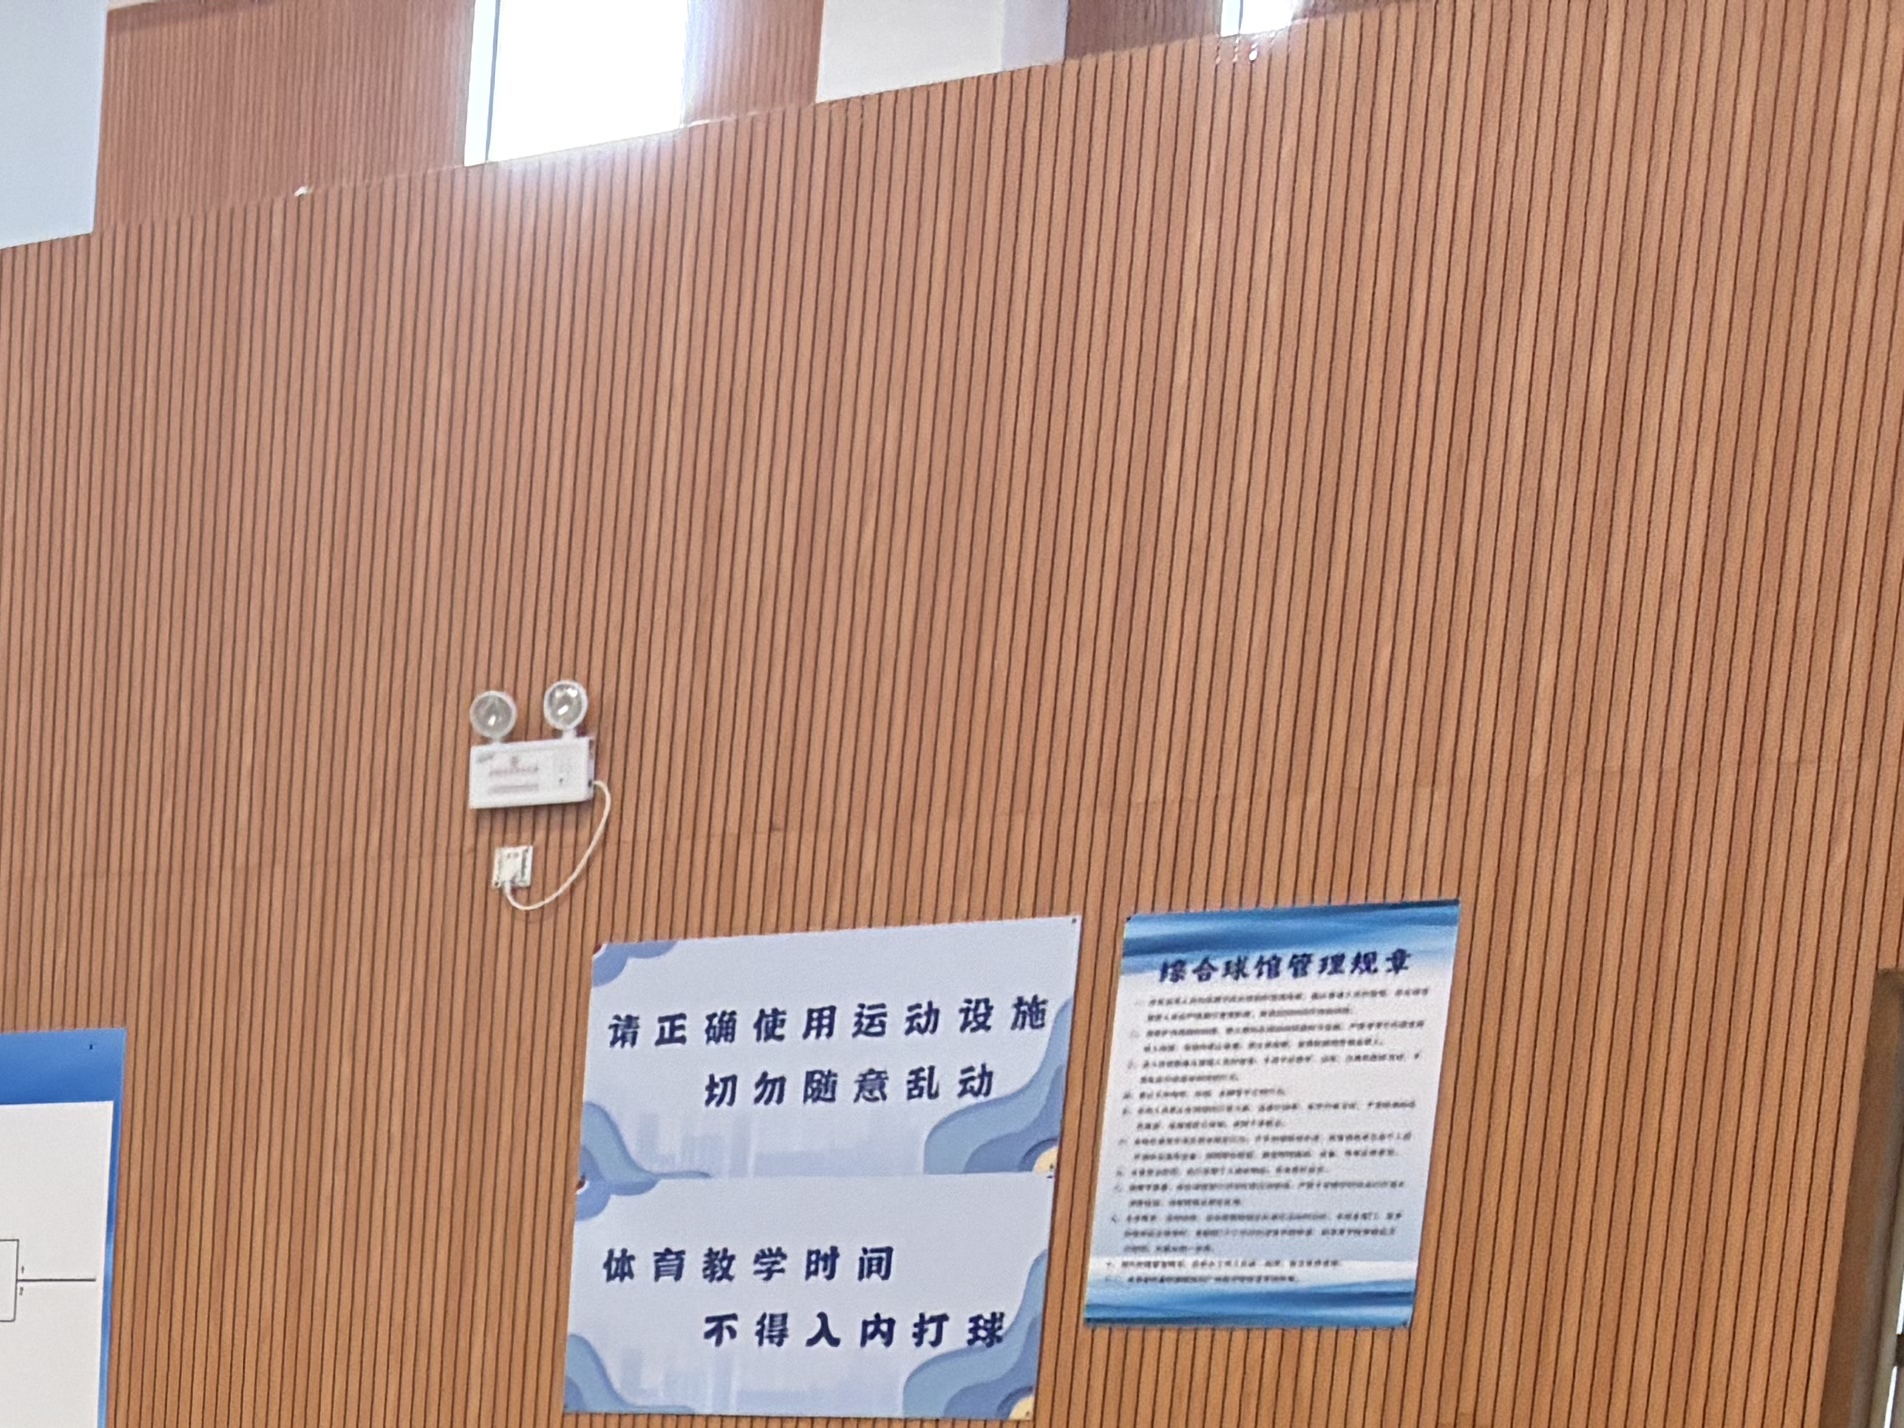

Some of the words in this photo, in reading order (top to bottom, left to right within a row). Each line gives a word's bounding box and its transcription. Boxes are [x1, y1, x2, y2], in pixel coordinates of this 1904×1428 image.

[1158, 948, 1411, 983] 综合球馆管理规章
[607, 994, 1049, 1049] 请正确使用运动设施
[704, 1063, 994, 1108] 切勿随意乱动
[602, 1246, 894, 1283] 体育教学时间
[703, 1312, 1006, 1348] 不得入内打球
